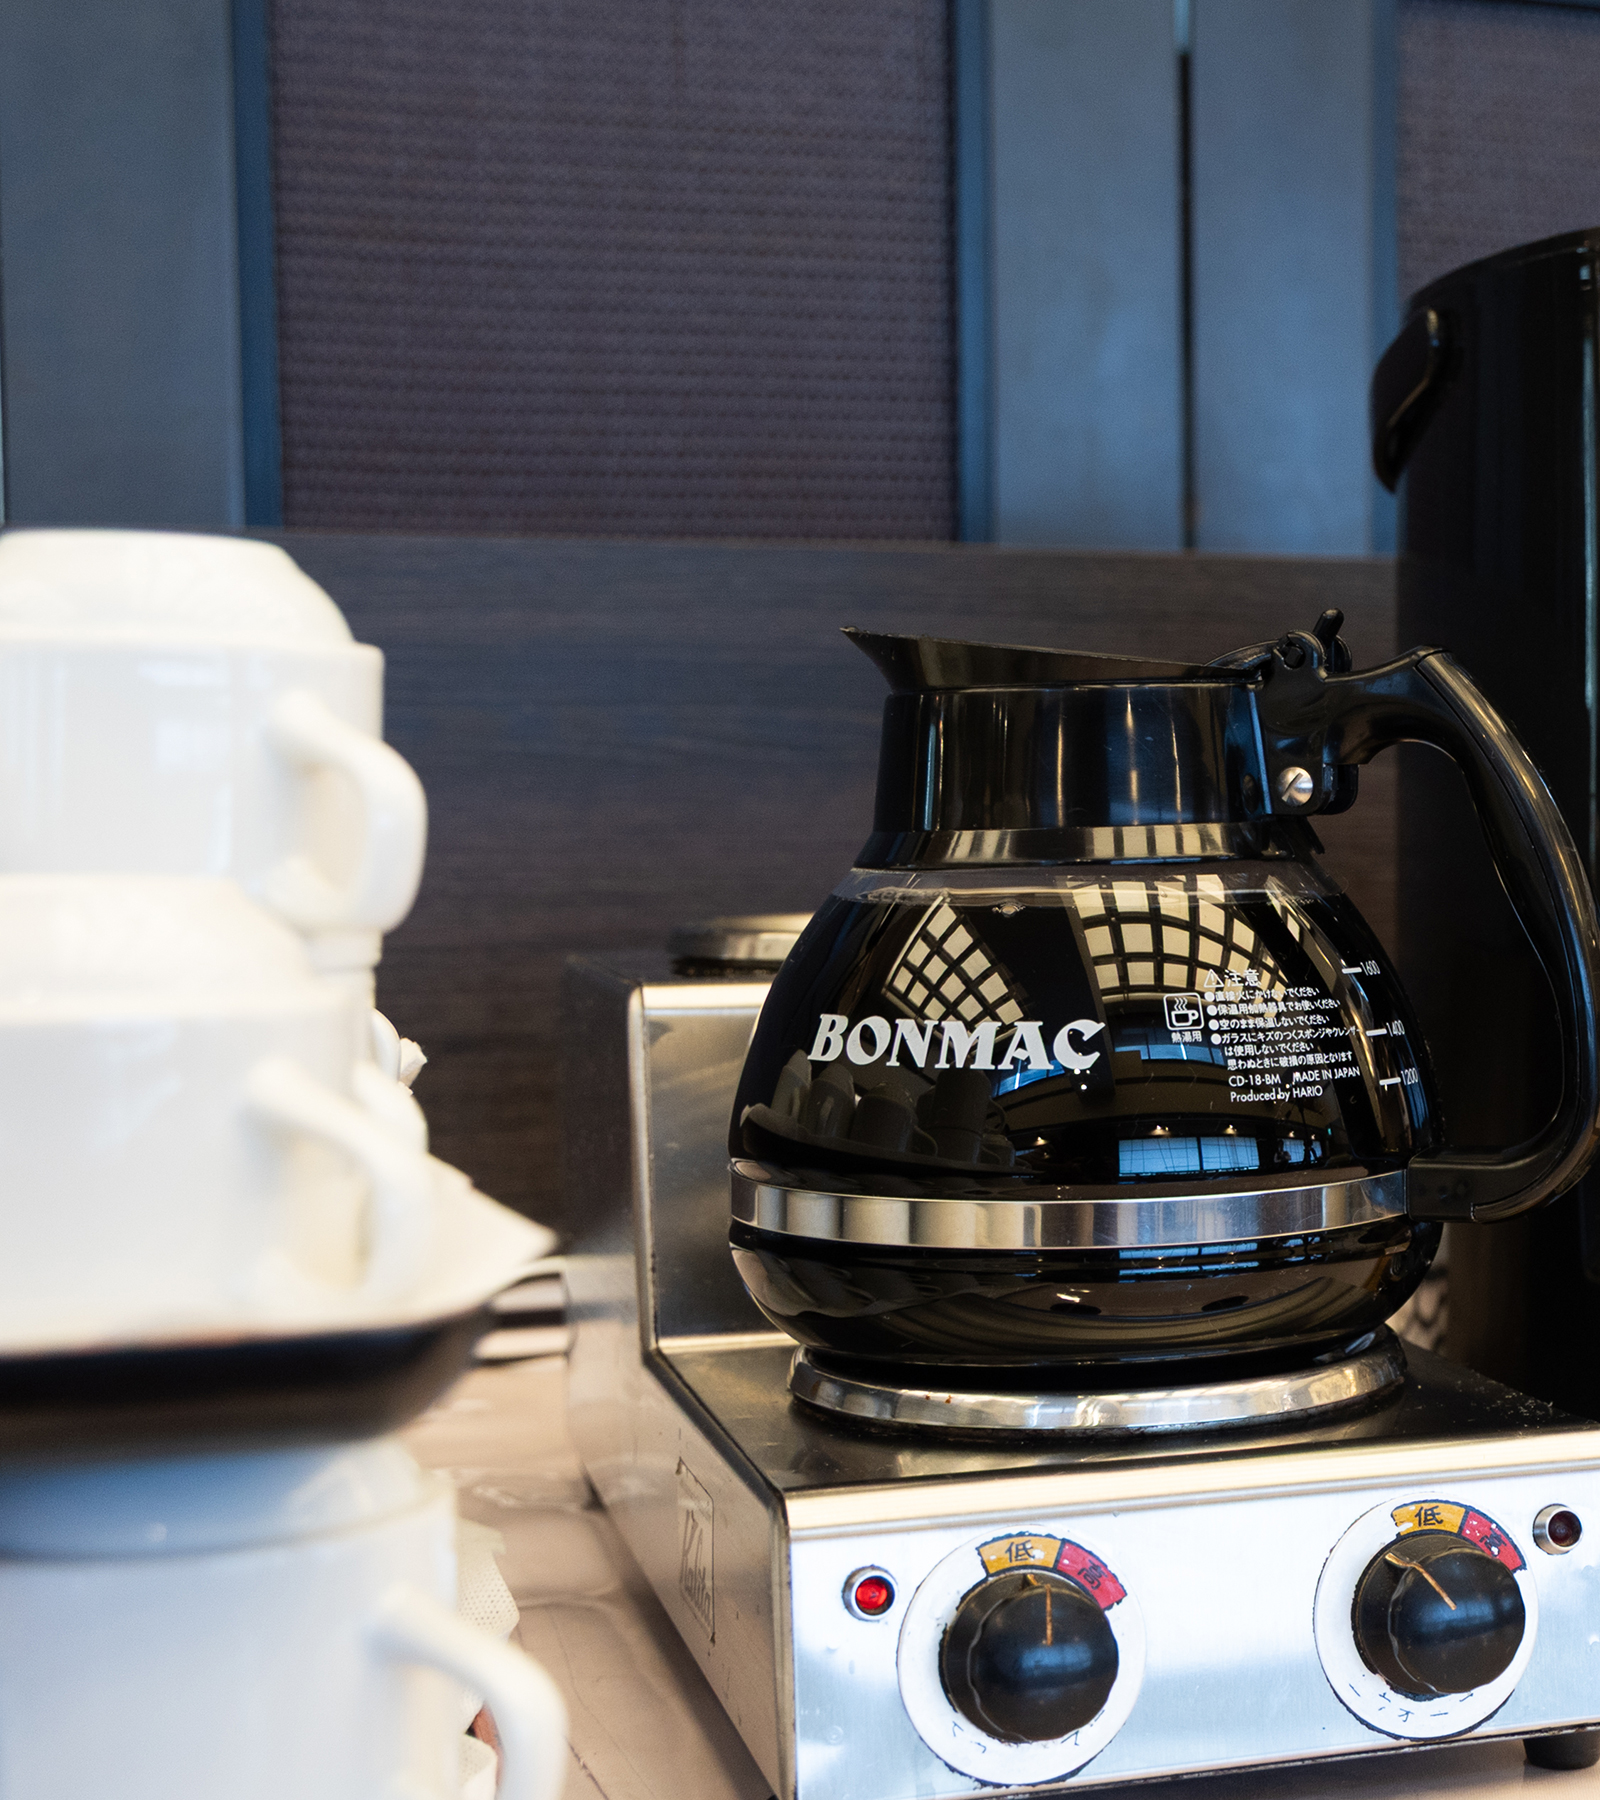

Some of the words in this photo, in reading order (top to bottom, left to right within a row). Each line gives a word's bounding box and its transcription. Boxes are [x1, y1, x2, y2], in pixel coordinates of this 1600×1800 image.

[1224, 968, 1262, 988] 注意
[1360, 961, 1381, 976] 1600
[1215, 987, 1320, 1002] 直接火にかけないでください
[1219, 1014, 1330, 1030] 空のまま保温しないでください
[1386, 1019, 1406, 1038] 1400
[806, 1013, 1106, 1070] BONMAC
[1171, 1030, 1203, 1044] 熱湯用
[1221, 1025, 1362, 1045] ガラスにキズのつくスポンジやクレンザー
[1224, 1042, 1314, 1057] は使用しないでください
[1226, 1050, 1353, 1072] 思わぬときに破損の原因となります
[1228, 1074, 1282, 1088] CD-18-BM
[1292, 1068, 1321, 1084] MADE
[1322, 1068, 1333, 1080] IN
[1334, 1065, 1361, 1080] JAPAN
[1400, 1067, 1420, 1086] 1200
[1229, 1087, 1277, 1103] Produced
[1276, 1086, 1292, 1103] by
[1292, 1084, 1324, 1099] HARIO
[1414, 1505, 1444, 1527] 低
[1004, 1539, 1036, 1563] 低
